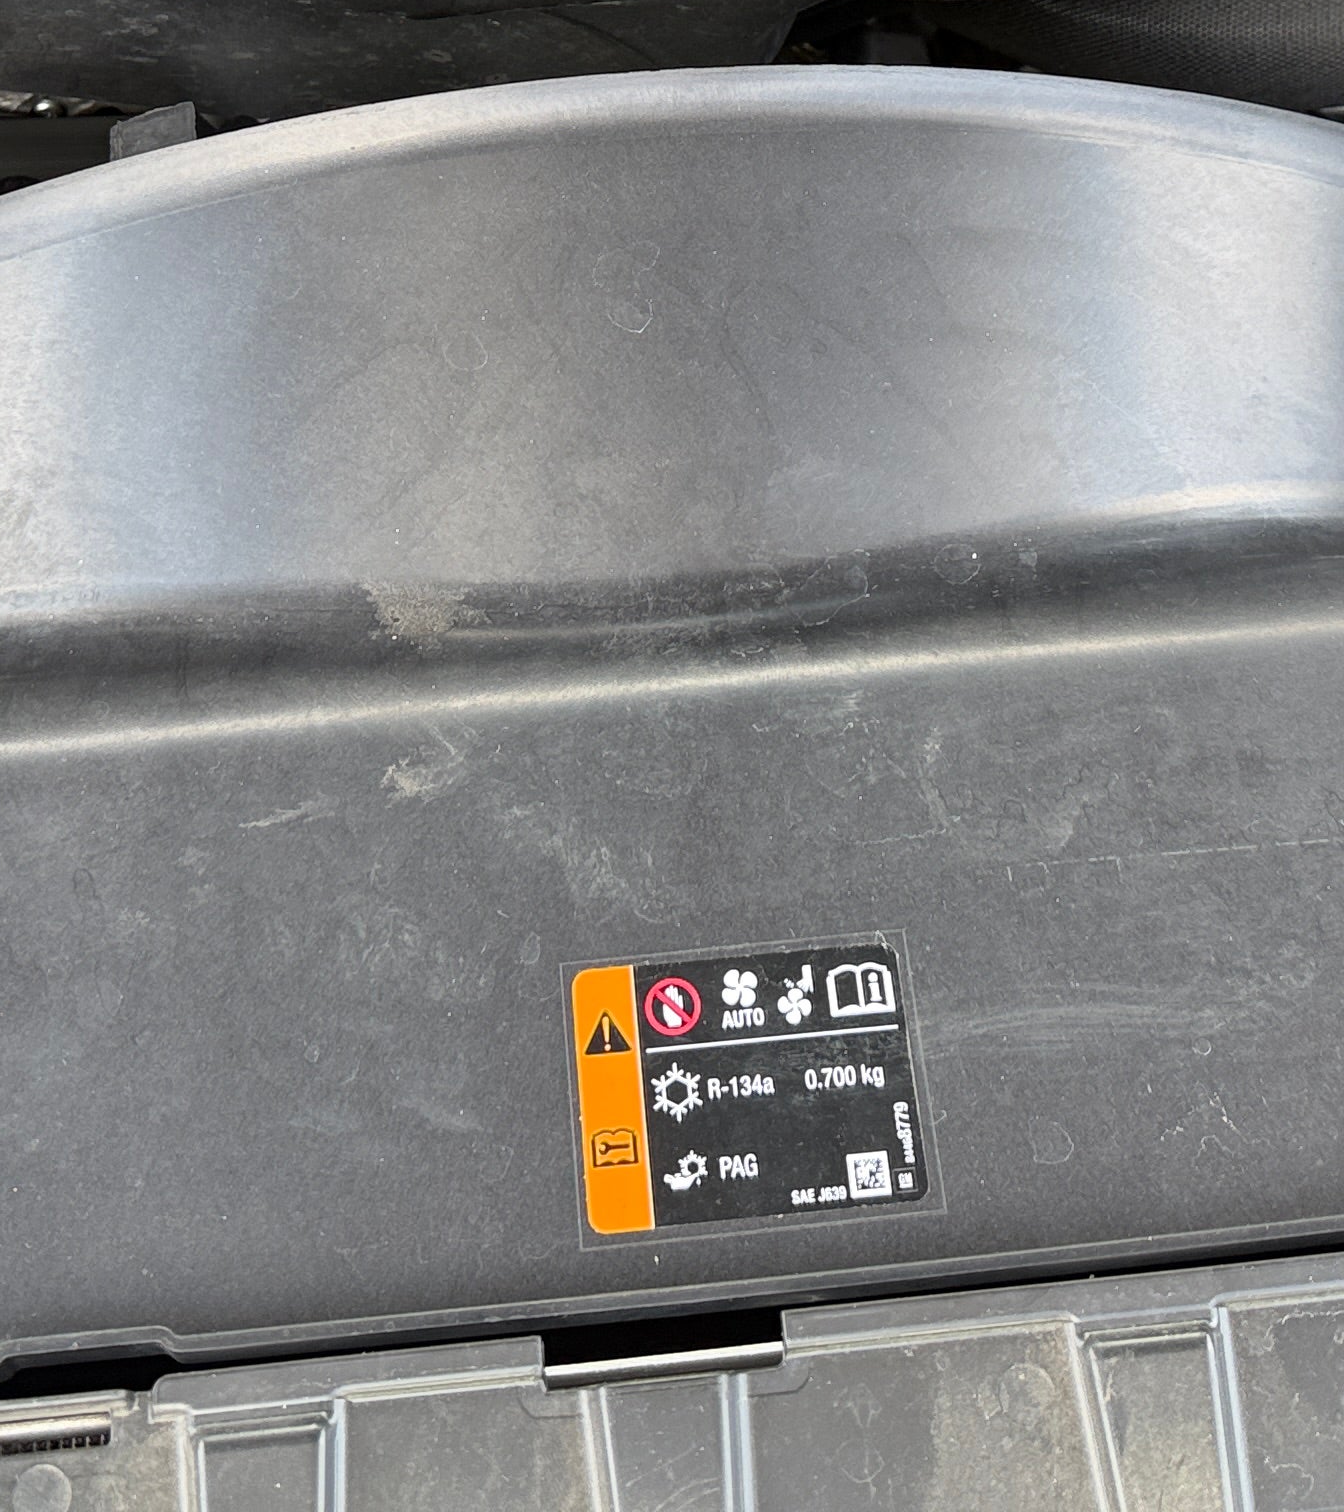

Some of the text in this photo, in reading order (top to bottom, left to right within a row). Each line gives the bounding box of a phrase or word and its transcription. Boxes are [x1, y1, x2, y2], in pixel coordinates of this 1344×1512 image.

[722, 1007, 765, 1030] AUTO
[707, 1063, 885, 1100] R-134a 0.700 kg
[719, 1153, 759, 1181] PAG
[791, 1185, 847, 1205] SAE J639
